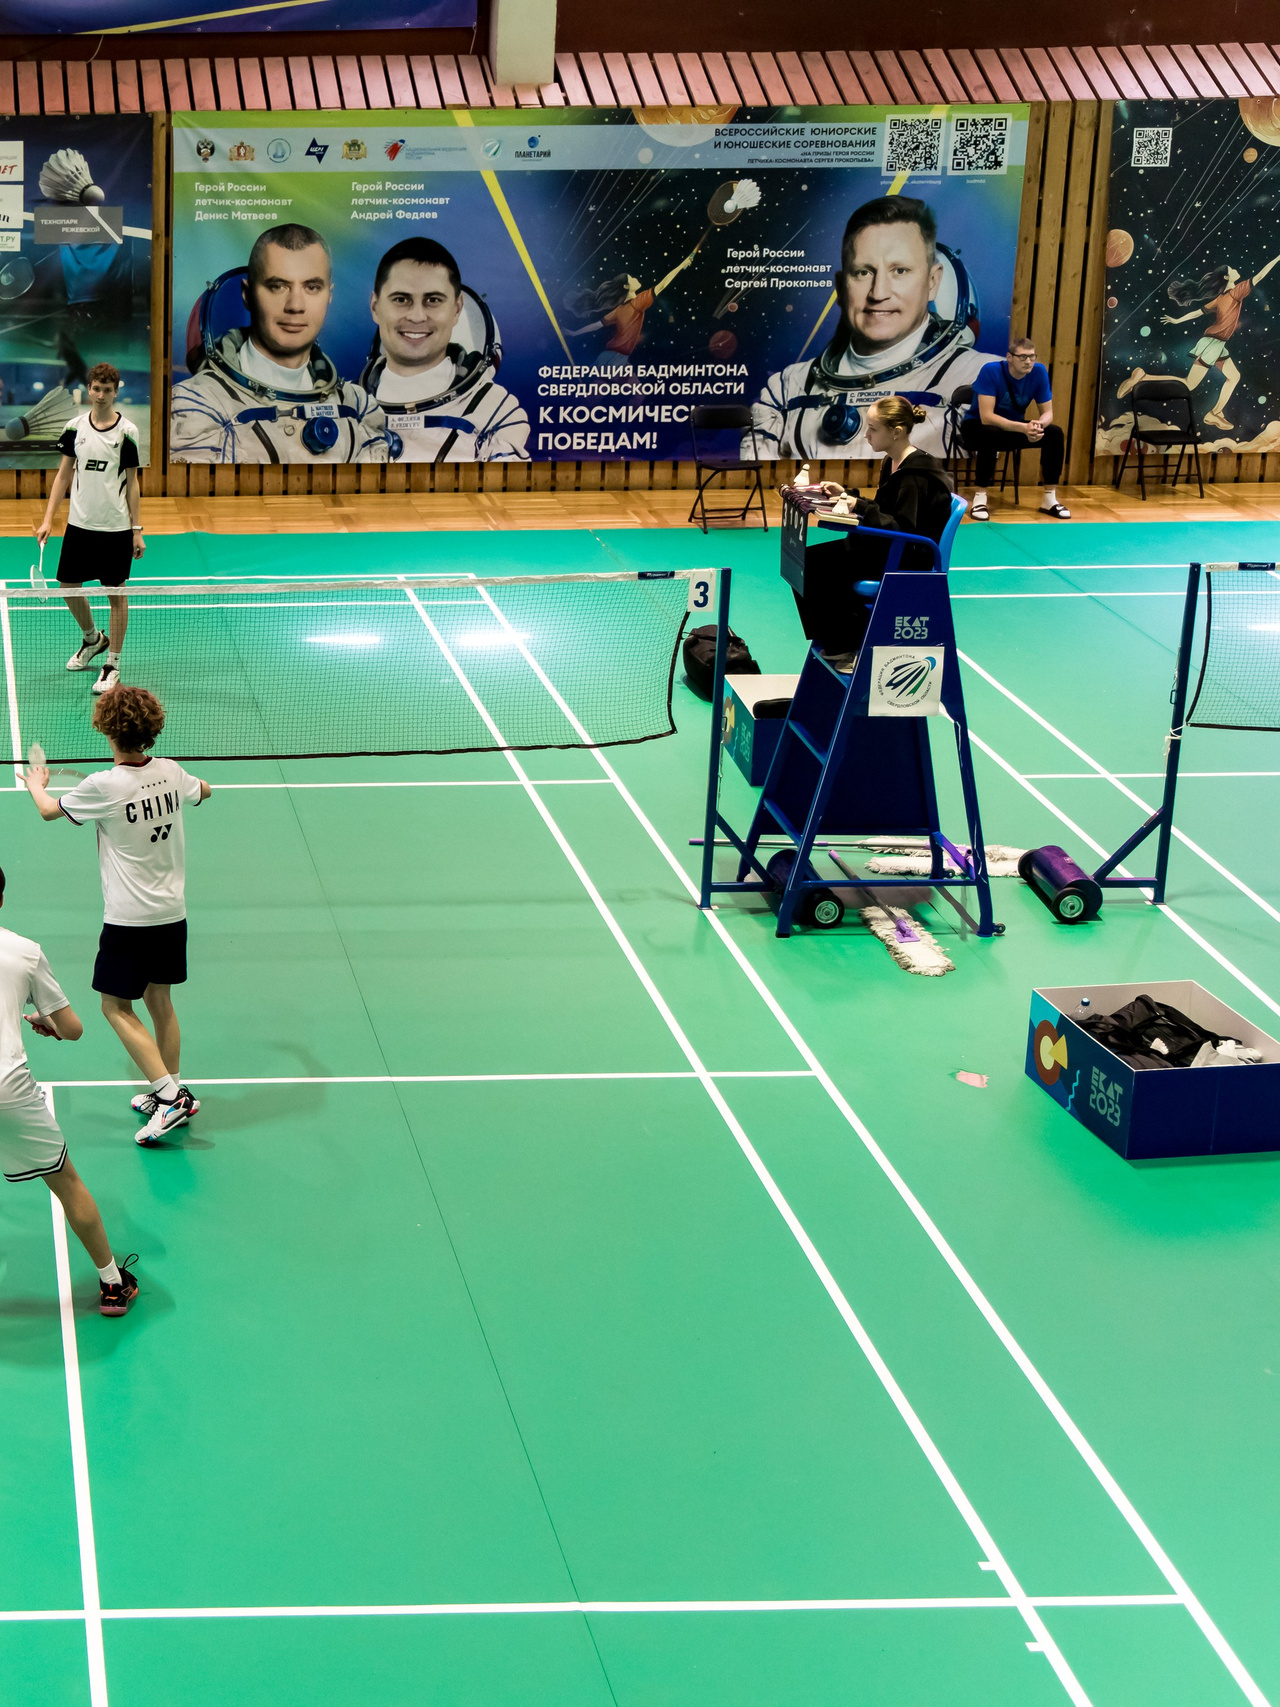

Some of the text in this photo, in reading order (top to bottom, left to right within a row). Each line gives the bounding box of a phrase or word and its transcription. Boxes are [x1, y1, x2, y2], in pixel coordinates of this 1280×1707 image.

[714, 126, 877, 137] ВСЕРОССИЙСКИЕ ЮНИОРСКИЕ
[713, 139, 876, 149] И ЮНОШЕСКИЕ СОРЕВНОВАНИЯ
[514, 149, 551, 158] ПЛАНЕТАРИЙ
[194, 182, 267, 194] Герой России
[351, 181, 425, 193] Герой России
[194, 198, 293, 206] летчик-космонавт
[351, 196, 450, 206] летчик-космонавт
[194, 211, 278, 221] Денис Матвеев
[350, 210, 438, 222] Андрей Федяев
[727, 247, 805, 260] Герой России
[725, 264, 832, 273] летчик-космонавт
[724, 278, 833, 290] Сергей Прокопьев
[538, 364, 749, 380] ФЕДЕРАЦИЯ БАДМИНТОНА
[537, 380, 745, 398] СВЕРДЛОВСКОЙ ОБЛАСТИ
[538, 405, 696, 424] К КОСМИЧЕС
[537, 432, 658, 453] ПОБЕДАМ!
[84, 459, 109, 472] 20
[693, 581, 709, 608] 3
[895, 616, 930, 627] EKAT
[893, 627, 928, 639] 2023
[125, 790, 180, 824] CHINA
[1091, 1066, 1123, 1103] EKAT
[1089, 1084, 1121, 1127] 2023
